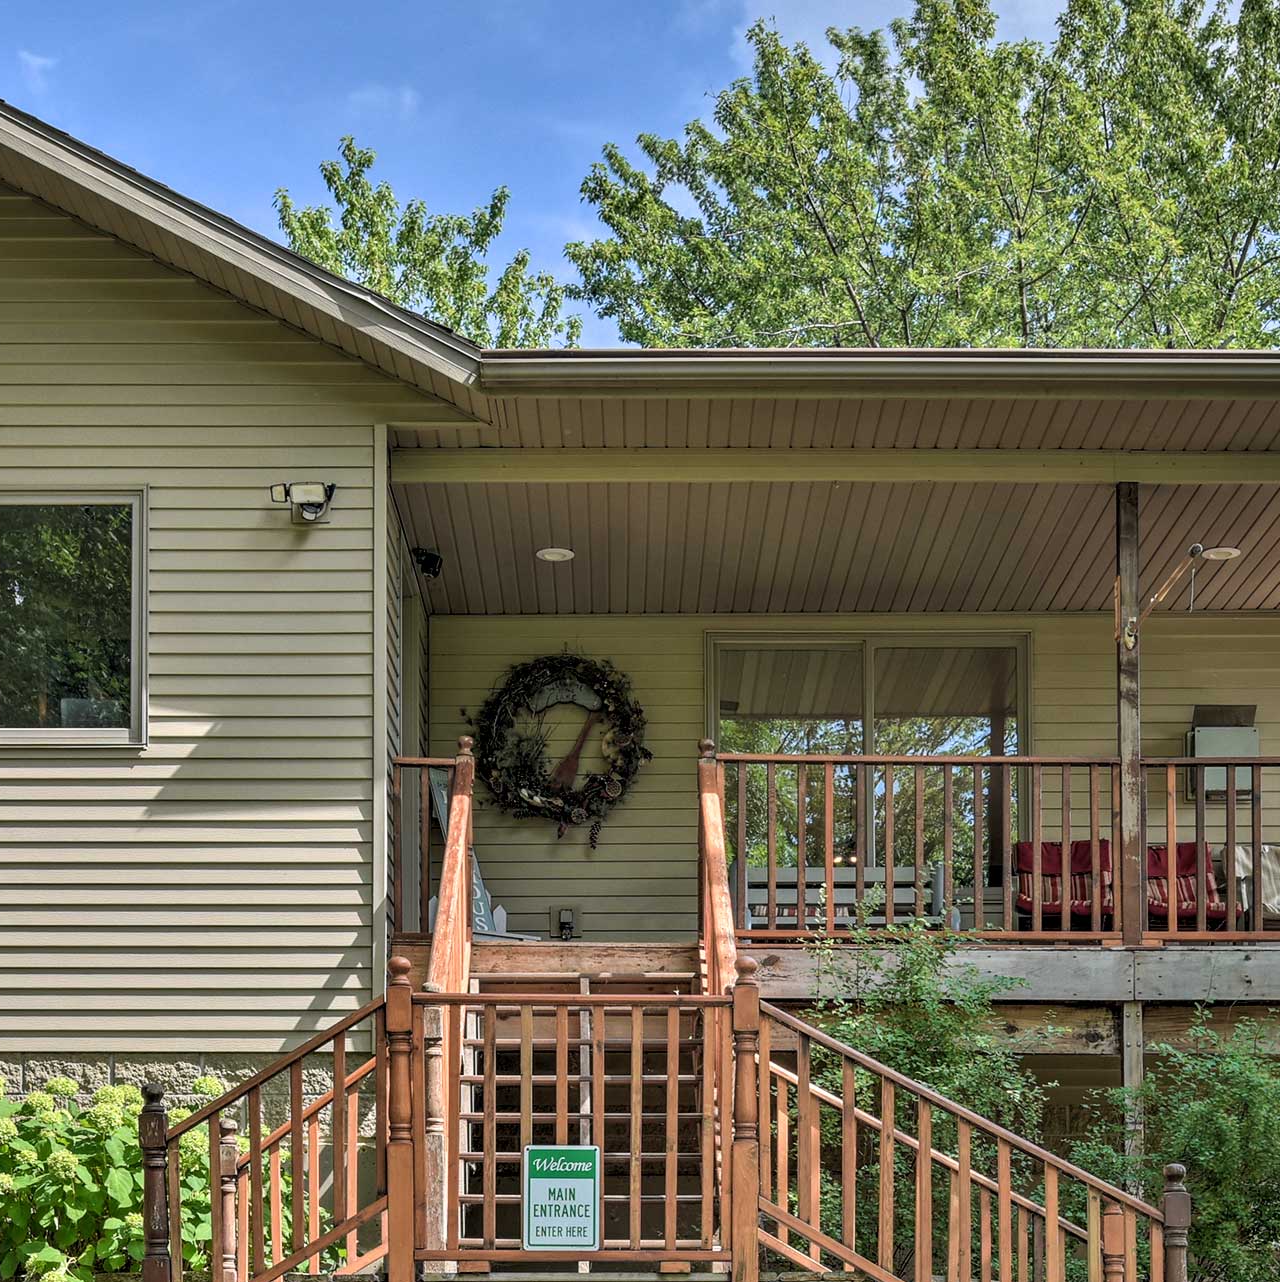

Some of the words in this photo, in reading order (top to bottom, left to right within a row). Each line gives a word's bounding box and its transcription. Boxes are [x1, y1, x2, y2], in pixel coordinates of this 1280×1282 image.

[533, 1157, 592, 1172] Welcome
[548, 1187, 576, 1201] MAIN
[533, 1204, 591, 1218] ENTRANCE
[535, 1226, 563, 1237] ENTER
[566, 1226, 588, 1237] HERE
